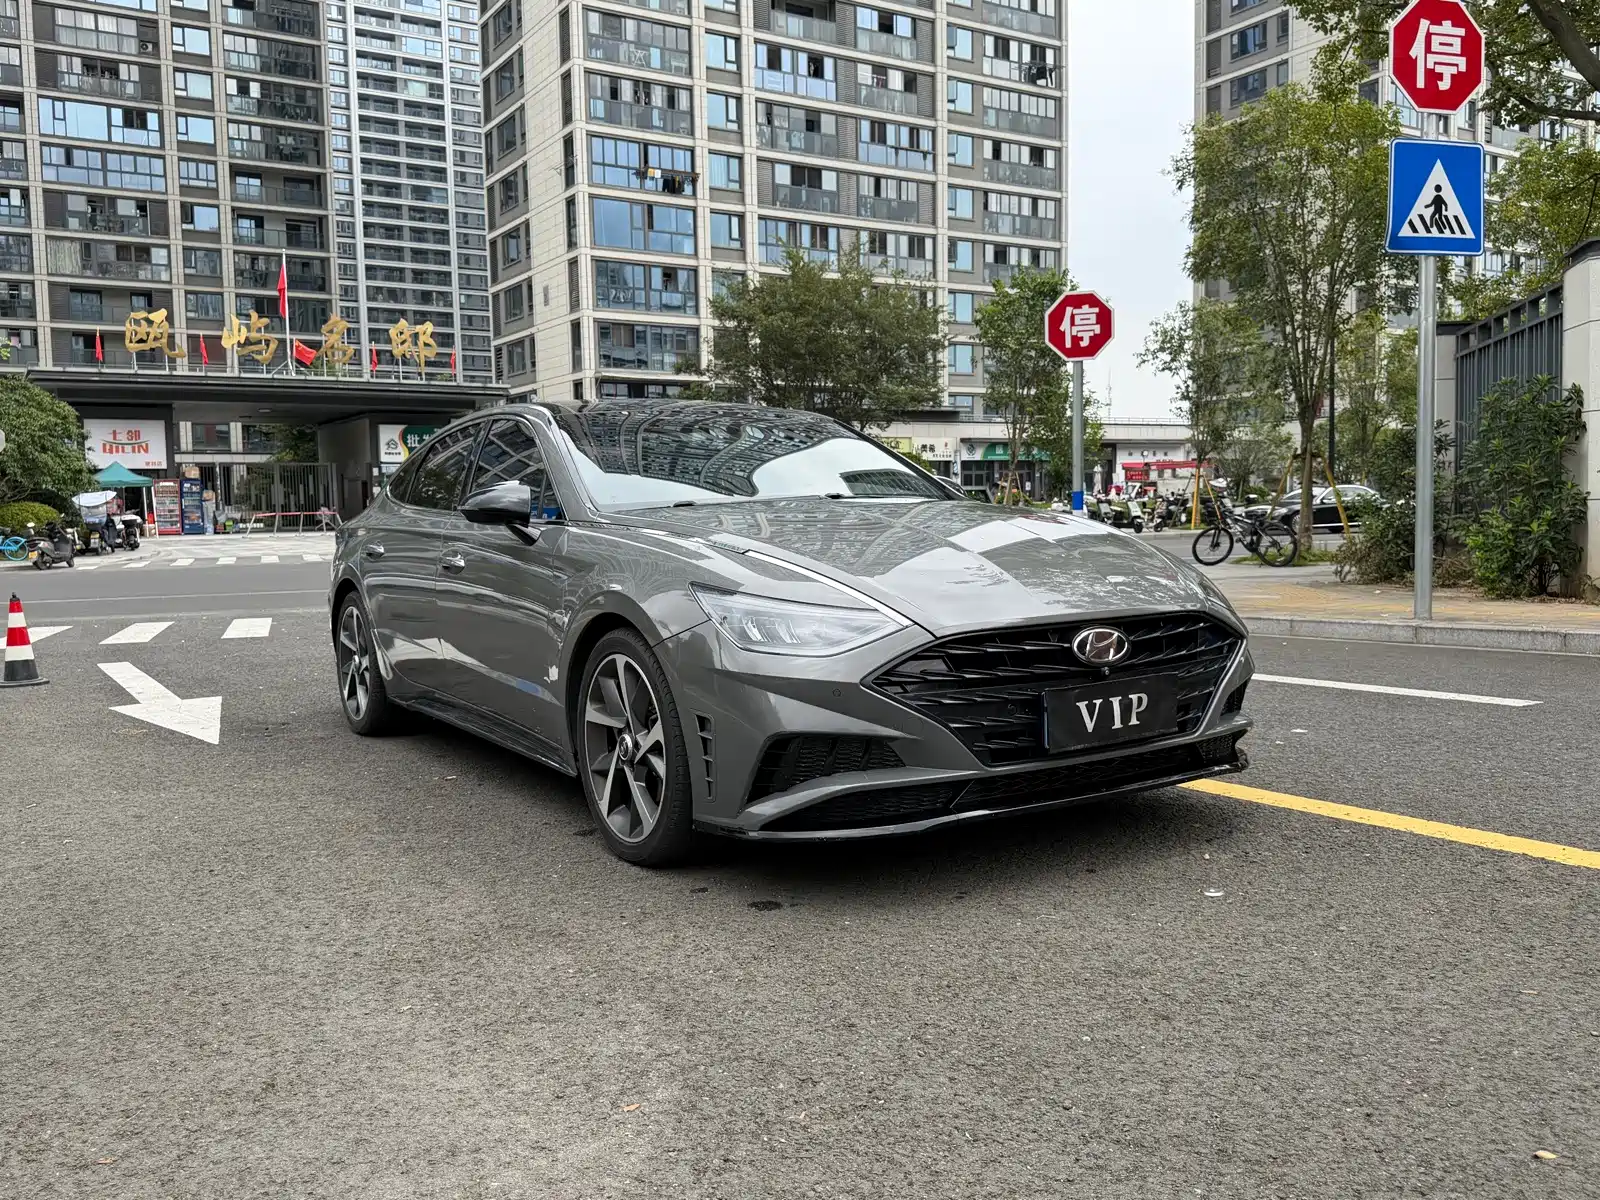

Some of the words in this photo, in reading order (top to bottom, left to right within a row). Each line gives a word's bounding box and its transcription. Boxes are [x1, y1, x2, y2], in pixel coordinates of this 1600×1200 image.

[1408, 17, 1466, 91] 停
[1059, 304, 1101, 349] 停
[102, 442, 149, 455] QILIN
[1076, 693, 1148, 733] VIP
